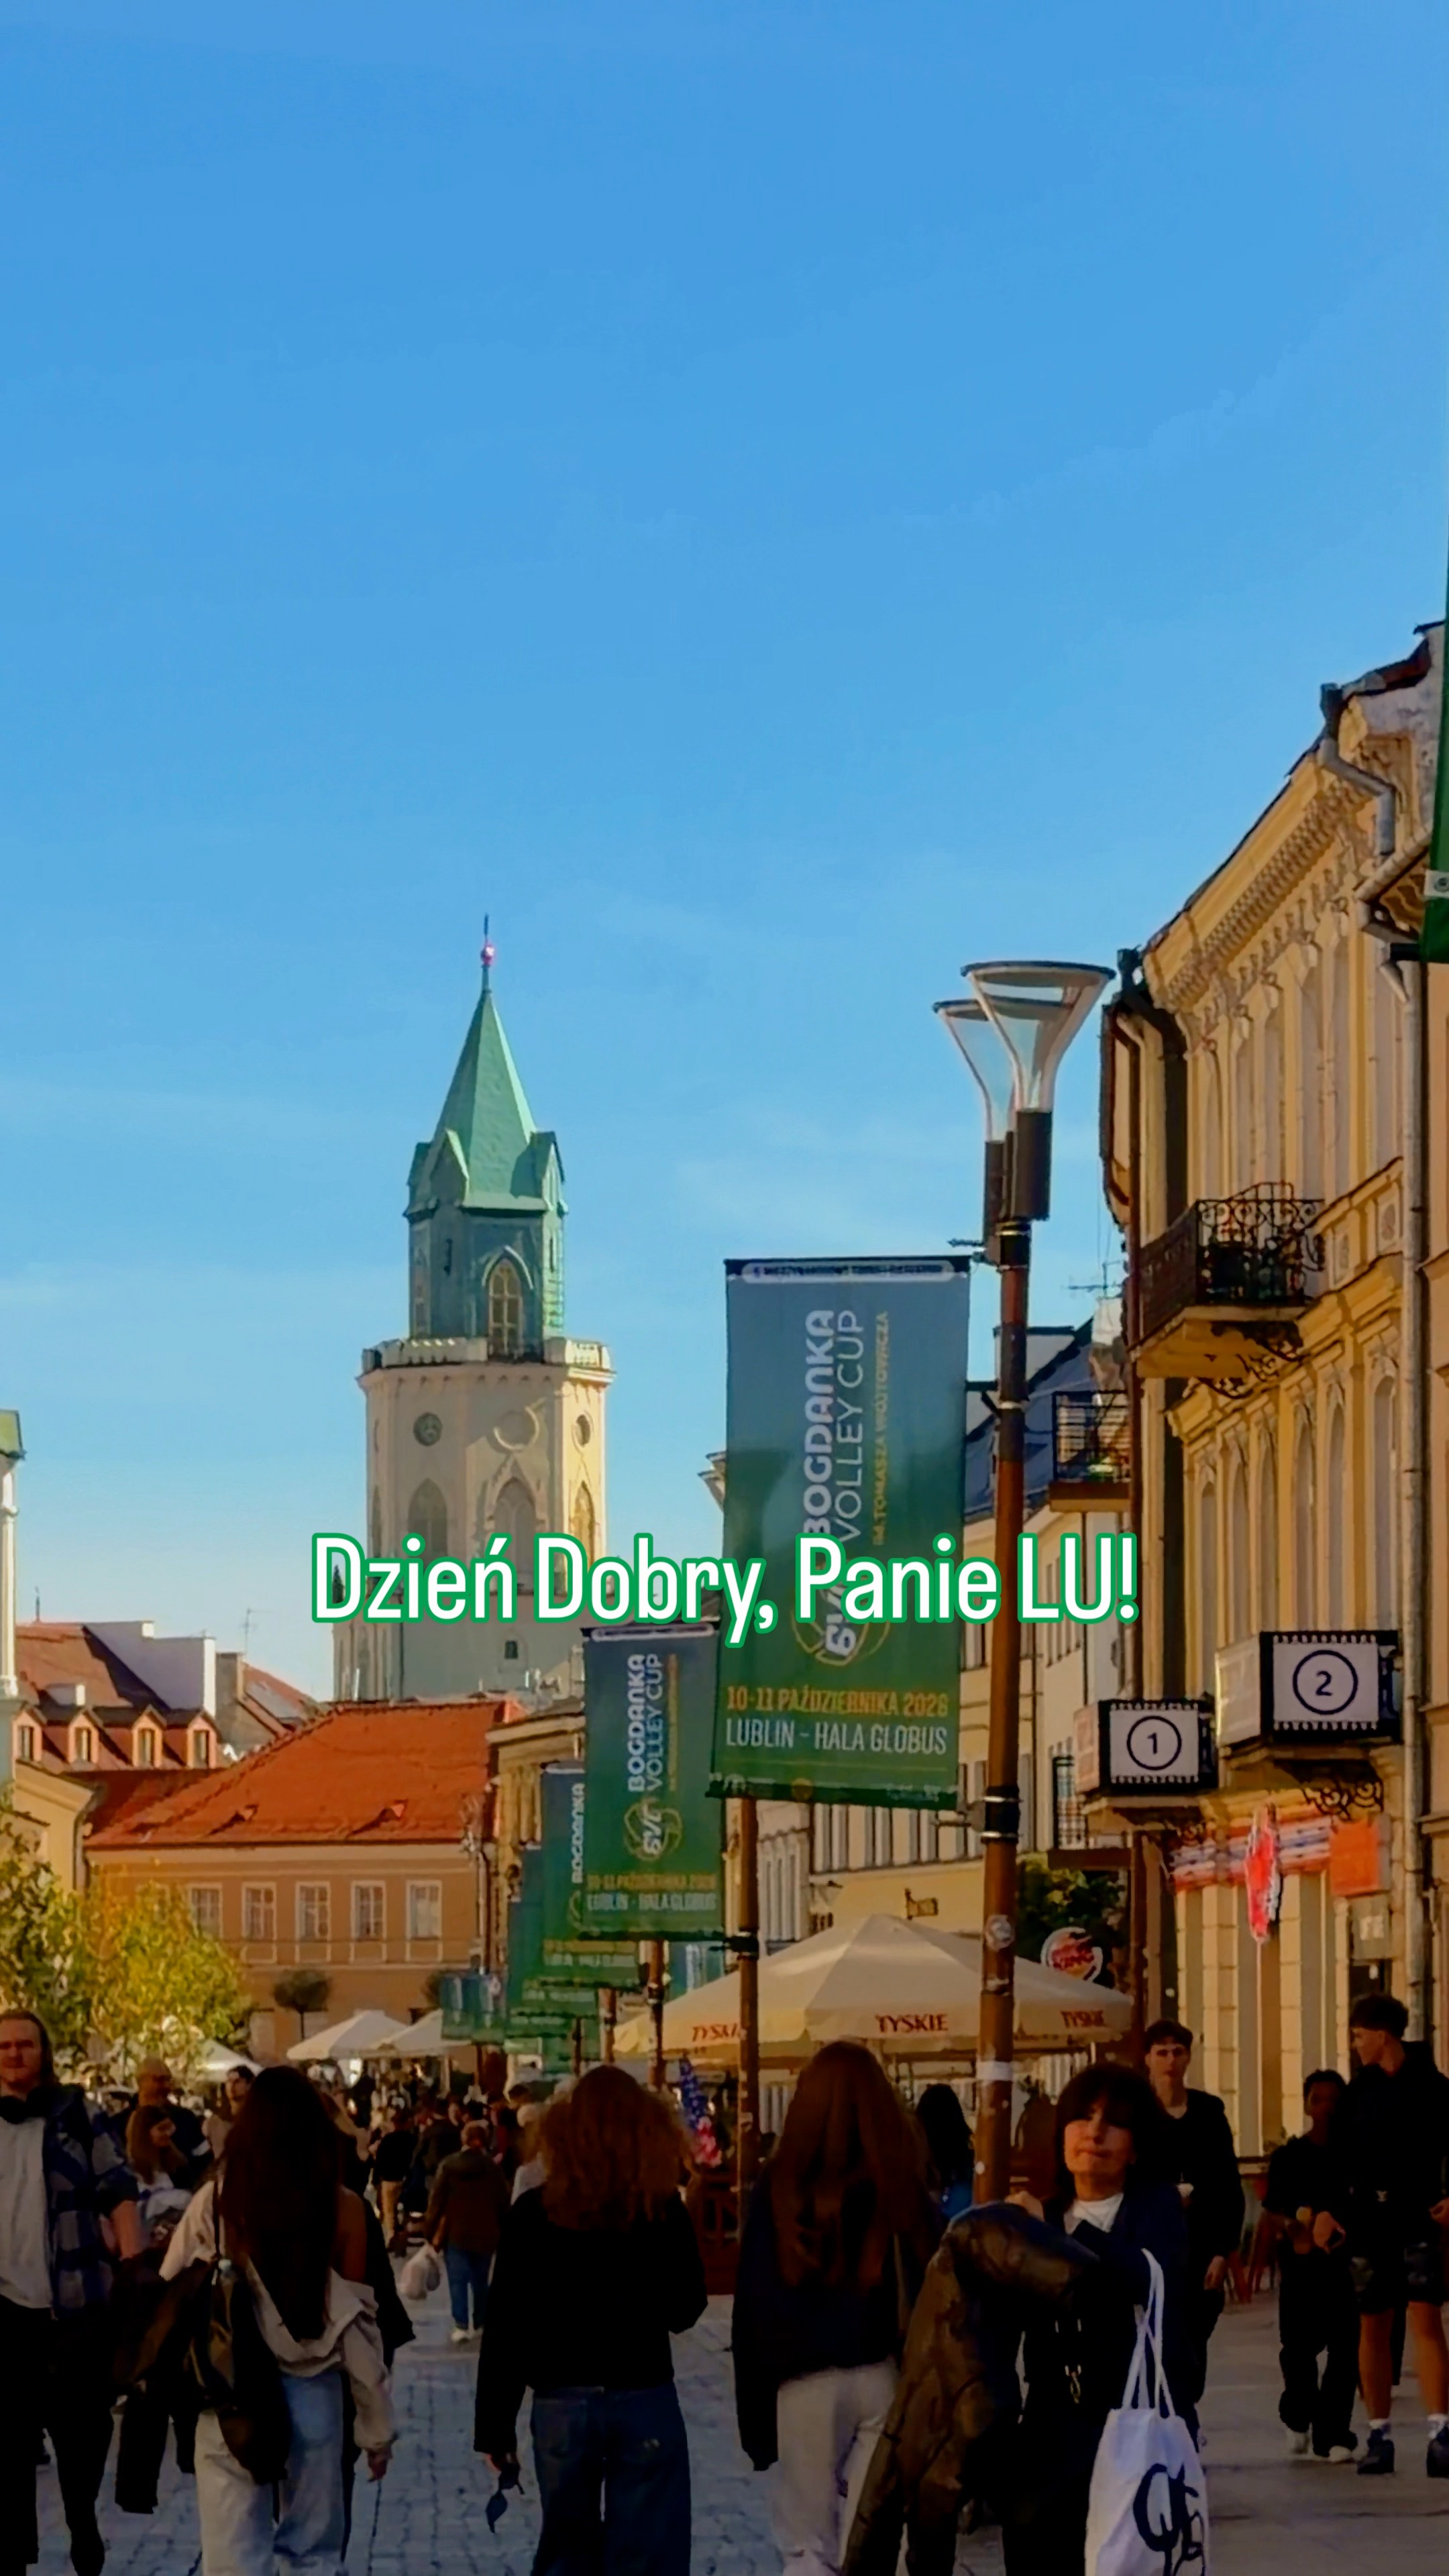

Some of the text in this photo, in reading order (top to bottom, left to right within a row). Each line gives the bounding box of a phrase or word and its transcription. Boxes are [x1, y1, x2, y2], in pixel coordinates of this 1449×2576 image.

[804, 1309, 835, 1534] BOGDANKA
[832, 1310, 865, 1542] VOLLEY CUP
[627, 1654, 645, 1792] BOGDANKA
[645, 1654, 663, 1791] VOLLEY CUP
[1316, 1670, 1333, 1696] 2
[727, 1718, 794, 1748] LUBLIN
[814, 1721, 865, 1752] HALA
[871, 1725, 948, 1755] GLOBUS
[1146, 1733, 1159, 1755] 1
[875, 2013, 949, 2033] TYSKIE
